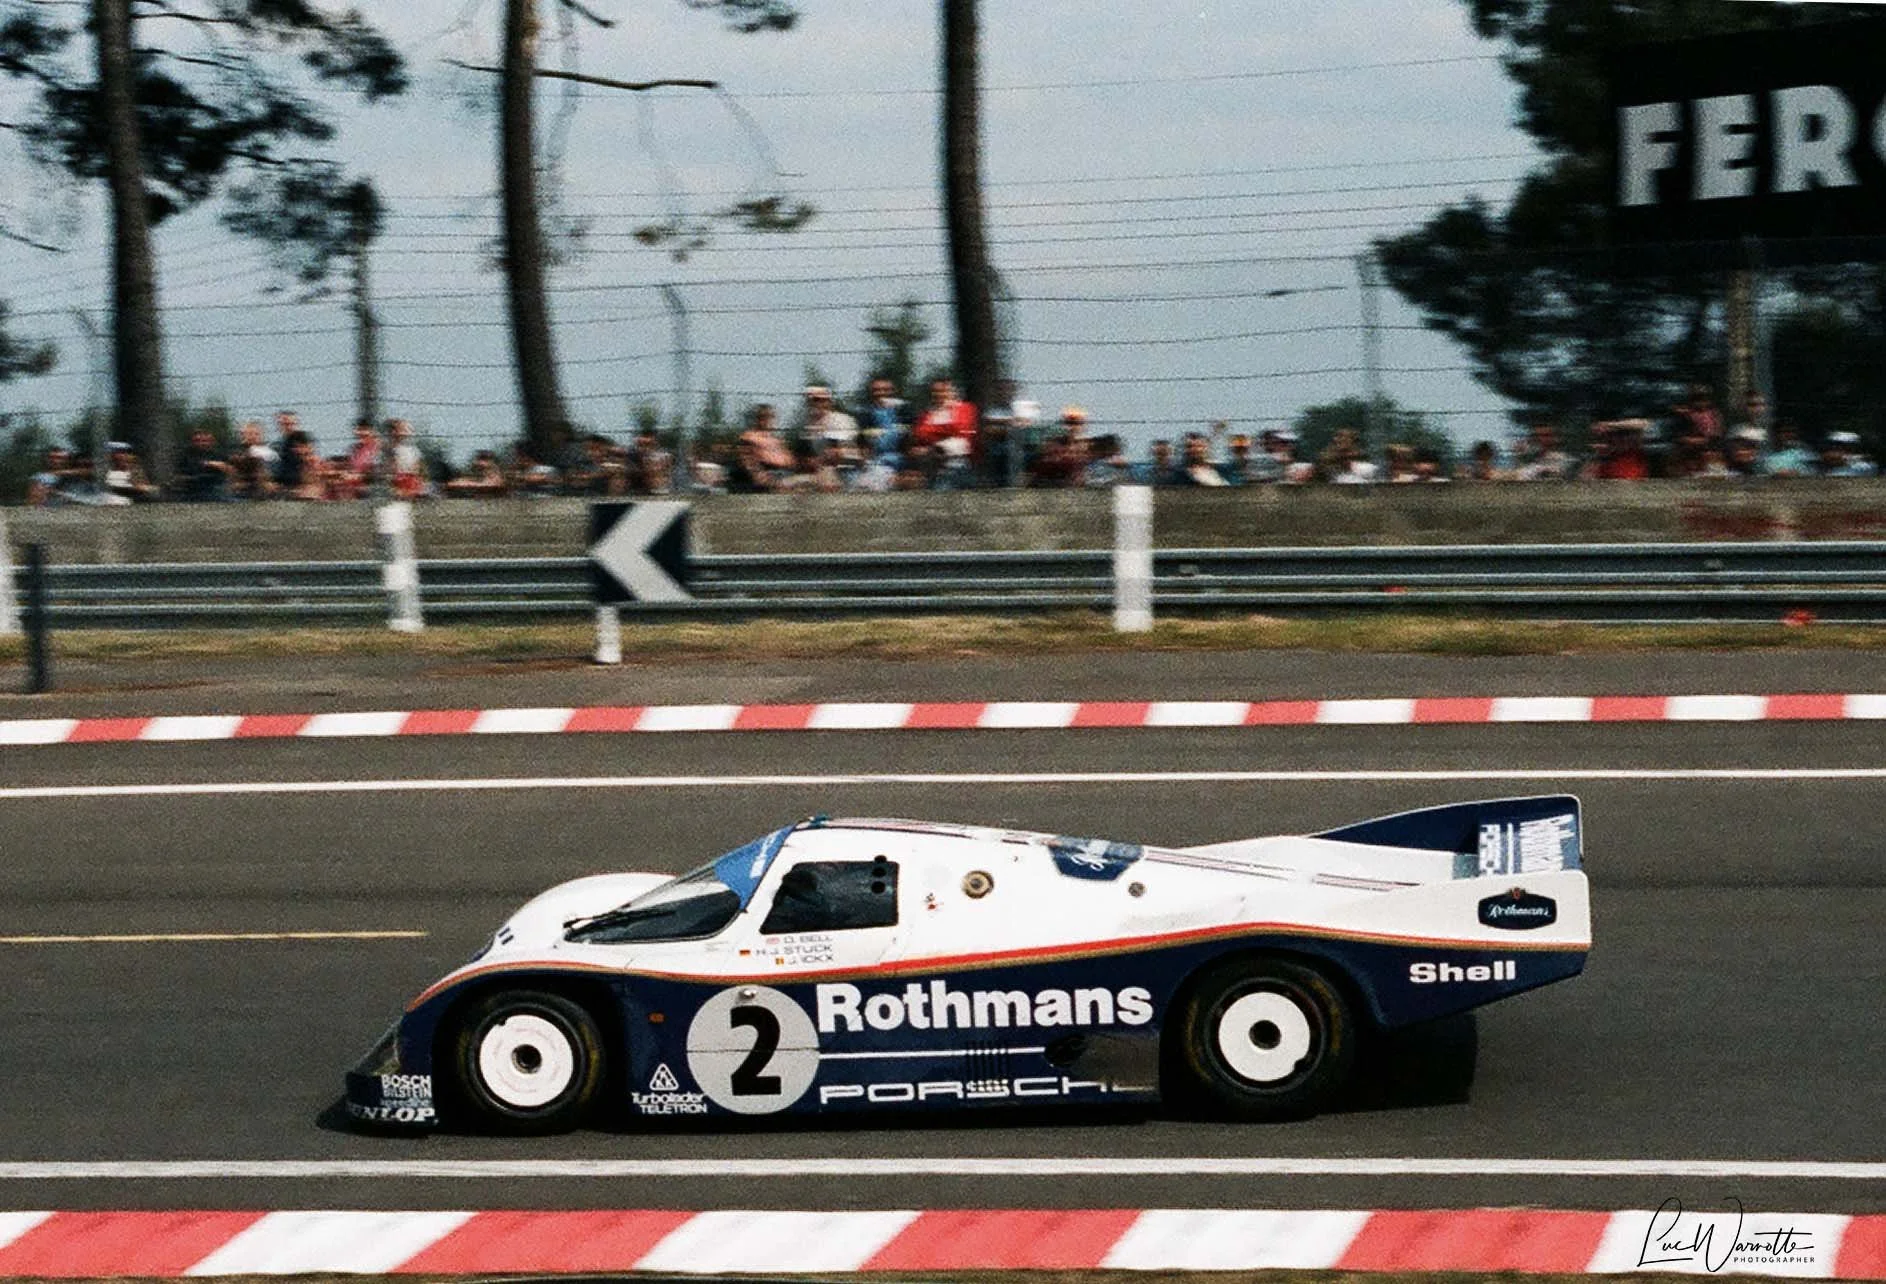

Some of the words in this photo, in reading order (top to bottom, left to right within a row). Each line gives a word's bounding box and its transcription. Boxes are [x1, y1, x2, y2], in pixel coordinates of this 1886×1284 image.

[1616, 84, 1886, 207] FER
[1410, 960, 1516, 983] Shell
[816, 980, 1153, 1032] Rothmans
[730, 1005, 782, 1096] 2
[381, 1074, 432, 1089] BOSCH
[631, 1092, 704, 1104] Turbolader
[640, 1103, 707, 1114] TELETRON
